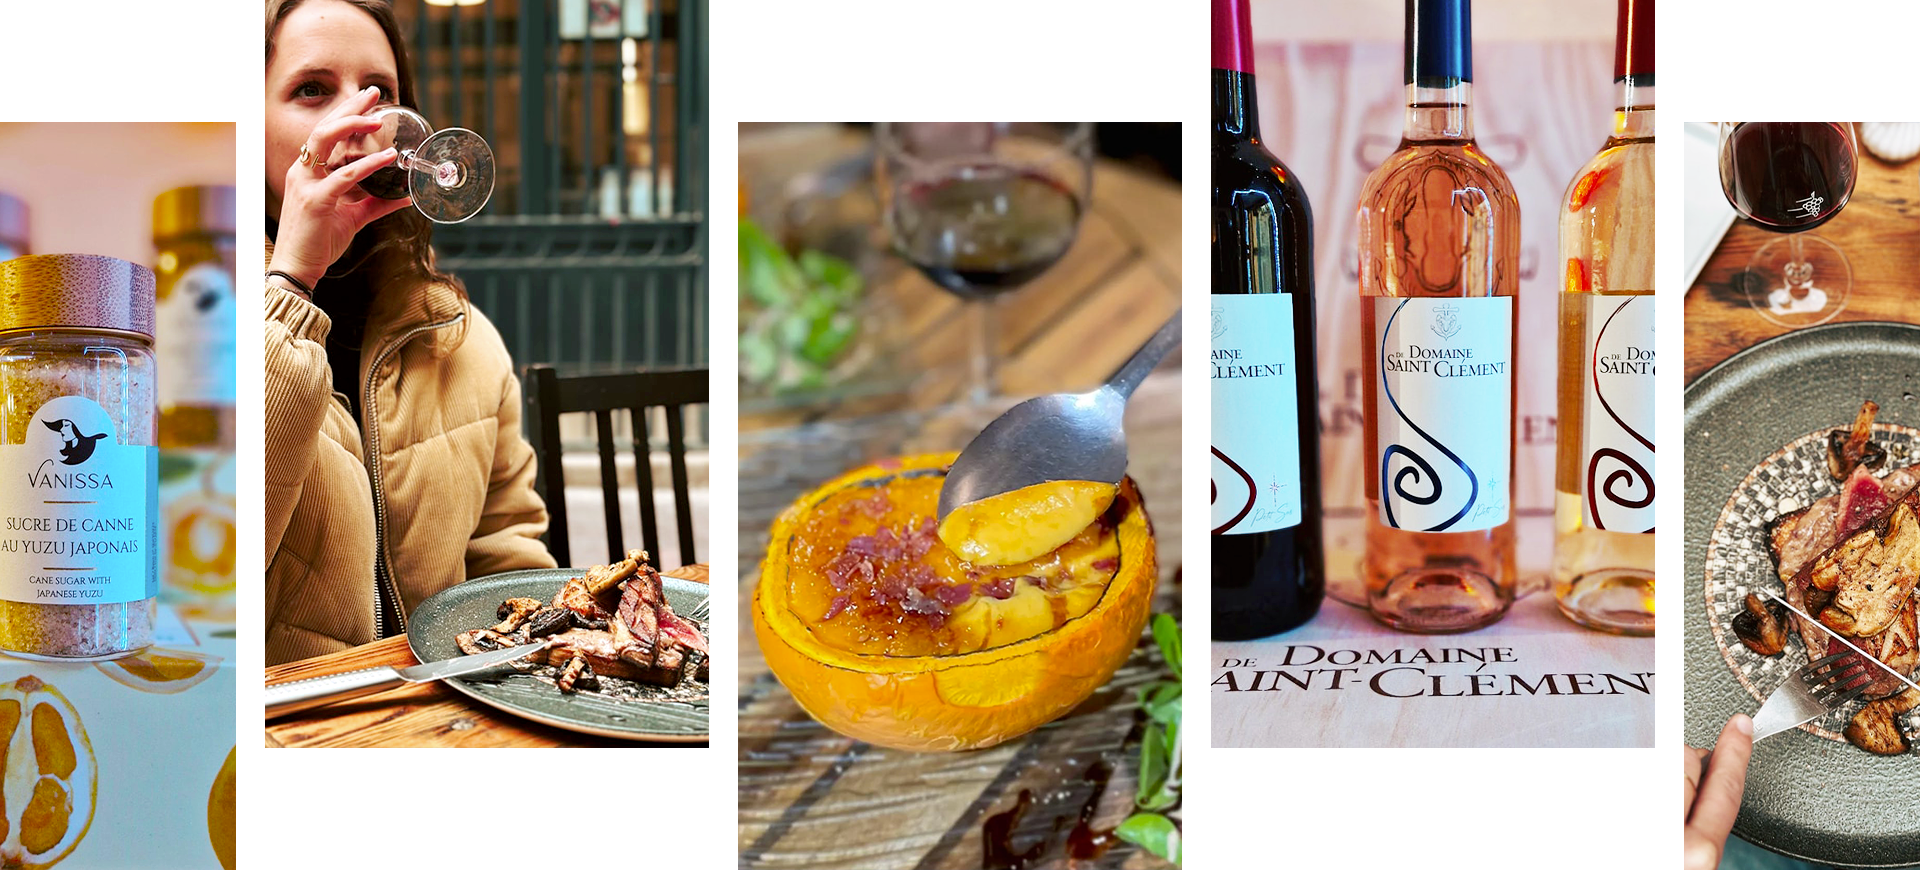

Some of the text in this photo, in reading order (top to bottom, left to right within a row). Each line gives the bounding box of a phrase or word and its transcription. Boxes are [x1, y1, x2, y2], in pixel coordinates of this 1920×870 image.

[1408, 344, 1474, 359] DOMAINE
[1611, 346, 1655, 361] DE DO
[1387, 354, 1506, 378] SAINT CLÉMENT
[1599, 355, 1651, 375] SAINT
[28, 458, 114, 489] VANISSA
[6, 516, 134, 532] SUCRE DE CANNE
[1, 539, 139, 558] AU YUZU JAPONAIS
[29, 575, 112, 586] CANE SUGAR WITH
[36, 589, 104, 599] JAPANESE YUZU
[1221, 644, 1518, 668] DE DOMAINE
[1211, 662, 1656, 698] AINT-CLÉMEN
